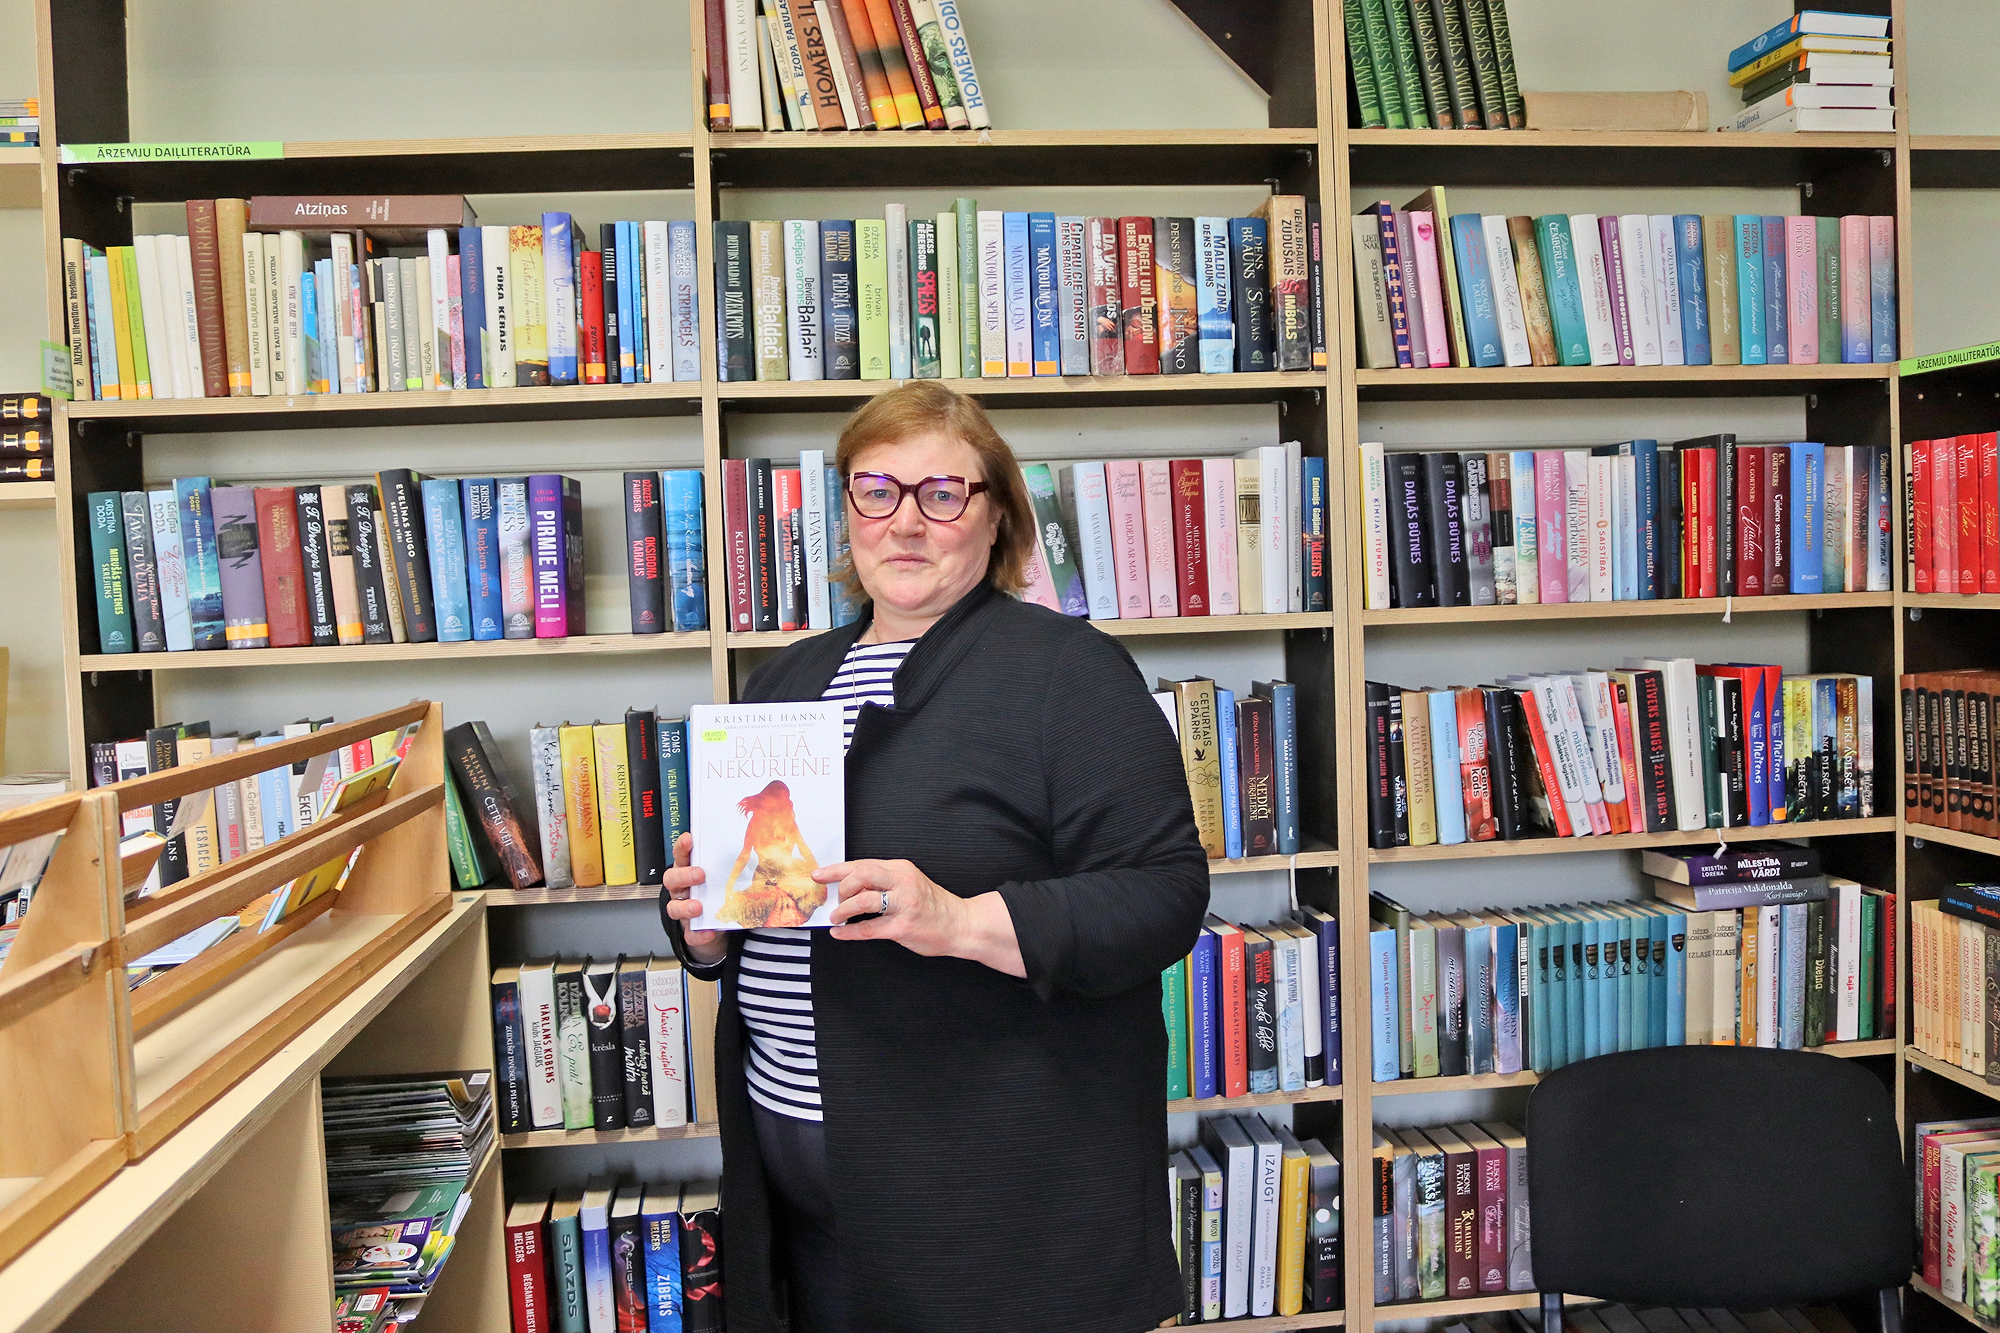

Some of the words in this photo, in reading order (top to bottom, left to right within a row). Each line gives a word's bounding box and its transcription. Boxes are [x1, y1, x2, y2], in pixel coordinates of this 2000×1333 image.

[951, 36, 983, 109] HOMĒRS
[97, 146, 151, 159] ĀRZEMJU
[155, 145, 252, 160] DAIĻLITERATŪRA
[294, 202, 348, 217] Atziņas
[791, 222, 805, 265] pēdējais
[838, 231, 851, 262] DEIVIDS
[863, 226, 872, 260] BARIJA
[917, 223, 927, 271] BĒRENSONS
[926, 223, 935, 254] ALEKSS
[1061, 222, 1070, 246] DENS
[1070, 222, 1084, 268] CIPARU
[1126, 222, 1137, 248] DENS
[1281, 219, 1296, 276] ZUDUŠAIS
[1612, 239, 1620, 258] TAVI
[247, 250, 257, 285] AVOTIEM
[965, 233, 974, 274] BRAISONS
[1062, 249, 1073, 287] BRAUNS
[1127, 250, 1139, 288] BRAUNS
[1213, 237, 1227, 279] MALDU
[1241, 229, 1255, 282] BRAUNS
[795, 266, 807, 305] varonis
[804, 277, 815, 305] Deivids
[831, 273, 850, 309] PĒDĒJĀ
[916, 270, 937, 315] SPIEGS
[1403, 260, 1417, 299] Holivuda
[1614, 260, 1624, 295] PIRKSTU
[724, 291, 745, 339] DŽEKPOTS
[864, 284, 874, 321] kritiens
[1072, 271, 1085, 341] CIETOKSNIS
[1216, 283, 1228, 313] ZONA
[1279, 278, 1300, 340] SIMBOLS
[251, 331, 260, 355] TAUTU
[797, 304, 817, 359] Baldači
[832, 313, 852, 343] JŪDZE
[1170, 307, 1188, 369] INFERNO
[1917, 356, 1946, 370] ĀRZEMJU
[1948, 344, 2000, 364] DAIĻLITERATŪR
[480, 484, 494, 521] KRISTĪNA
[1311, 476, 1321, 505] Entonijs
[1403, 480, 1418, 520] DAIĻĀS
[1443, 480, 1458, 519] DAIĻĀS
[96, 505, 106, 529] DODA
[104, 498, 117, 534] KRISTĪNA
[395, 483, 411, 528] EVELĪNAS
[404, 530, 416, 558] HUGO
[536, 509, 558, 566] PIRMIE
[759, 542, 767, 564] KURU
[809, 511, 823, 563] EVANSS
[1408, 522, 1422, 564] BŪTNES
[1448, 521, 1461, 563] BŪTNES
[1599, 530, 1609, 577] SAISTĪBAS
[133, 543, 150, 602] TUVUMA
[633, 540, 645, 577] KARALIS
[644, 536, 658, 579] OKSIDONA
[734, 530, 748, 605] KLEOPATRA
[1311, 540, 1323, 577] KLIENTS
[1375, 538, 1383, 578] STUNDAS
[112, 580, 125, 615] MEITENES
[312, 570, 327, 624] FINANSISTS
[540, 570, 560, 609] MELI
[760, 565, 769, 608] APROKAM
[1644, 677, 1661, 718] STĪVENS
[714, 712, 773, 724] KRISTĪNE
[781, 712, 827, 722] HANNA
[1190, 700, 1202, 741] SPĀRNS
[1199, 692, 1212, 746] CETURTAIS
[1410, 716, 1421, 756] KAULU
[661, 731, 672, 758] HANTS
[671, 730, 681, 754] TOMS
[735, 731, 812, 759] BALTĀ
[1467, 728, 1478, 760] Keiss
[1571, 730, 1585, 758] mātes
[1650, 721, 1663, 752] KINGS
[707, 757, 831, 779] NEKURIENE
[1471, 768, 1482, 797] kods
[616, 764, 629, 810] KRISTĪNE
[1655, 763, 1668, 816] 22.11.1963
[483, 796, 503, 826] ČETRI
[583, 803, 594, 839] HANNA
[620, 811, 631, 848] HANNA
[1702, 870, 1724, 878] LORENA
[1737, 857, 1781, 869] MĪLESTĪBA
[1751, 867, 1781, 878] VĀRDI
[1708, 885, 1743, 896] Patricija
[1743, 882, 1794, 893] Makdonalda
[1382, 951, 1391, 981] Viljams
[532, 1021, 540, 1038] klubs
[540, 1003, 552, 1045] HĀRLANS
[591, 1042, 617, 1052] krēsla
[544, 1047, 555, 1084] KOBENS
[1263, 1153, 1276, 1203] IZAUGT
[1456, 1164, 1465, 1196] PATAKI
[1486, 1159, 1495, 1191] PATAKI
[1493, 1159, 1501, 1191] ELISONE
[660, 1219, 672, 1244] BREDS
[1210, 1217, 1219, 1237] MŪSU
[1237, 1198, 1246, 1234] OBAMA
[514, 1232, 526, 1263] MELCERS
[525, 1230, 536, 1254] BREDS
[650, 1220, 662, 1251] MELCERS
[1235, 1240, 1243, 1272] IZAUGT
[561, 1233, 580, 1319] SLAZDS
[1210, 1278, 1218, 1299] DIENAS
[656, 1274, 673, 1317] ZIBENS
